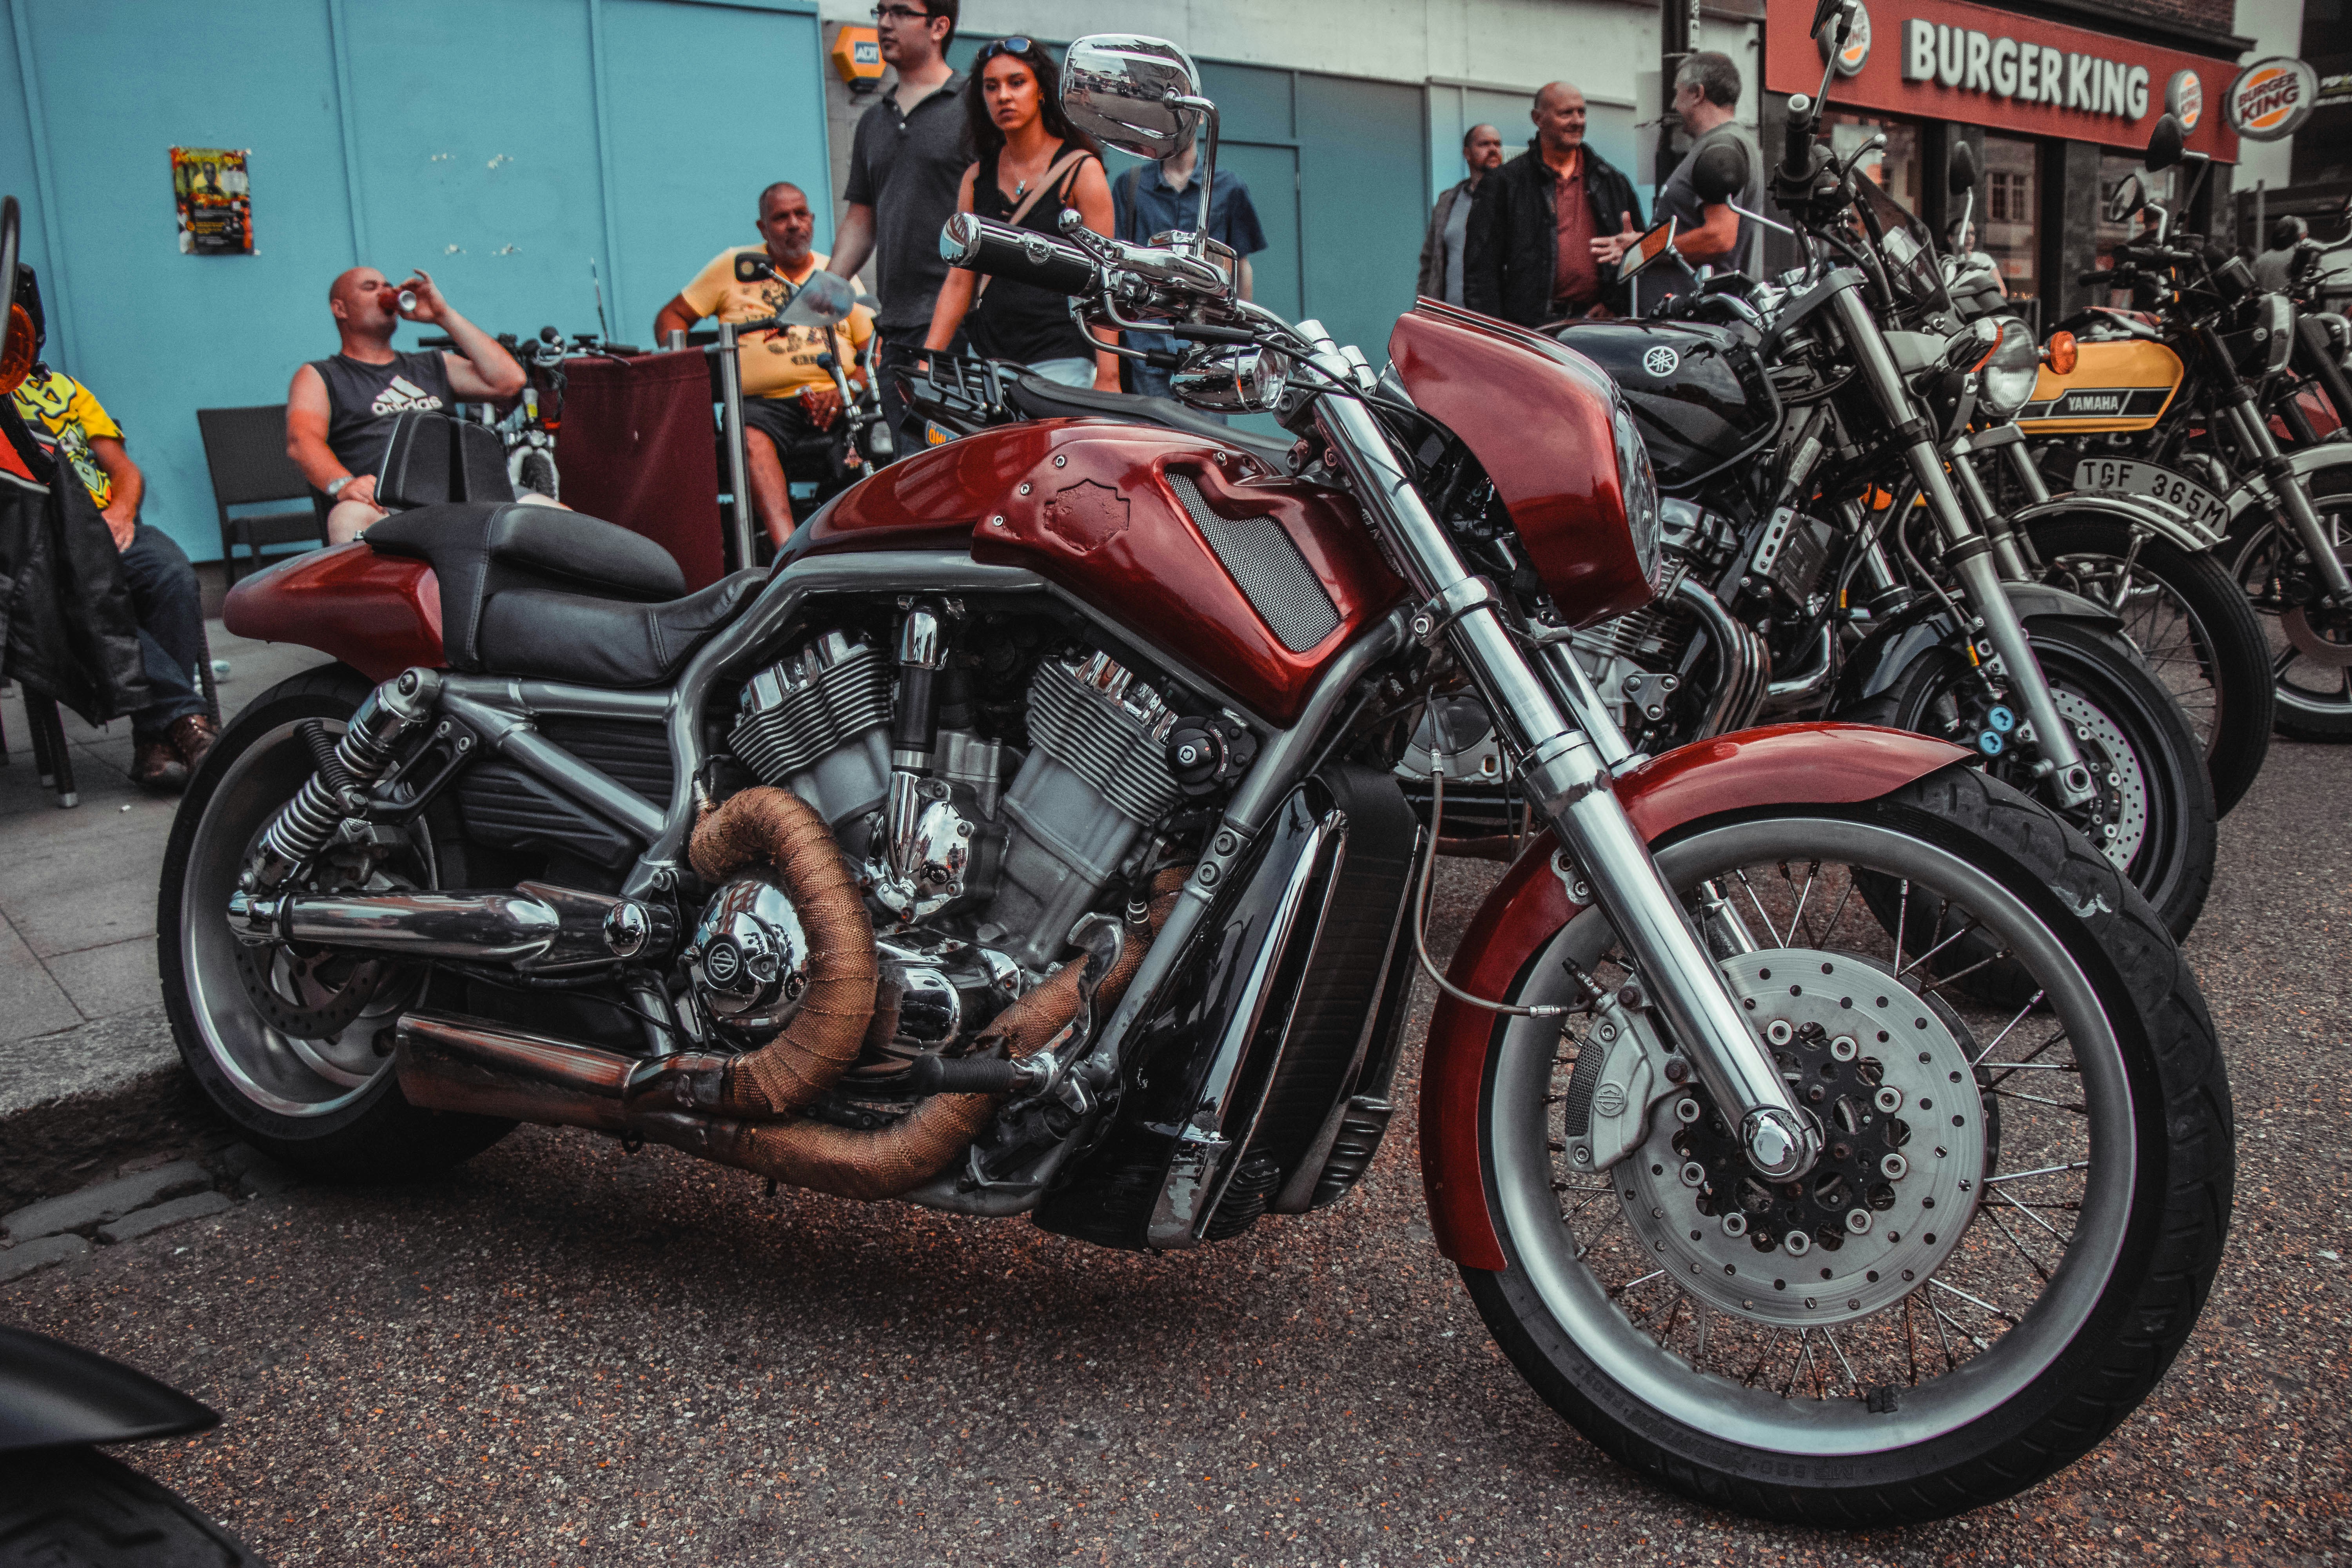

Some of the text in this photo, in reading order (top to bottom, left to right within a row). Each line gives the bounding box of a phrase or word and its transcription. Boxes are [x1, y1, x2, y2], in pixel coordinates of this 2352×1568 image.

[1909, 18, 2150, 120] BURGER KING
[2239, 72, 2298, 107] BURGER
[2241, 85, 2300, 125] KING
[2069, 396, 2118, 411] YAMAHA
[2082, 461, 2225, 528] TGF 365M
[1213, 729, 1222, 737] ACC
